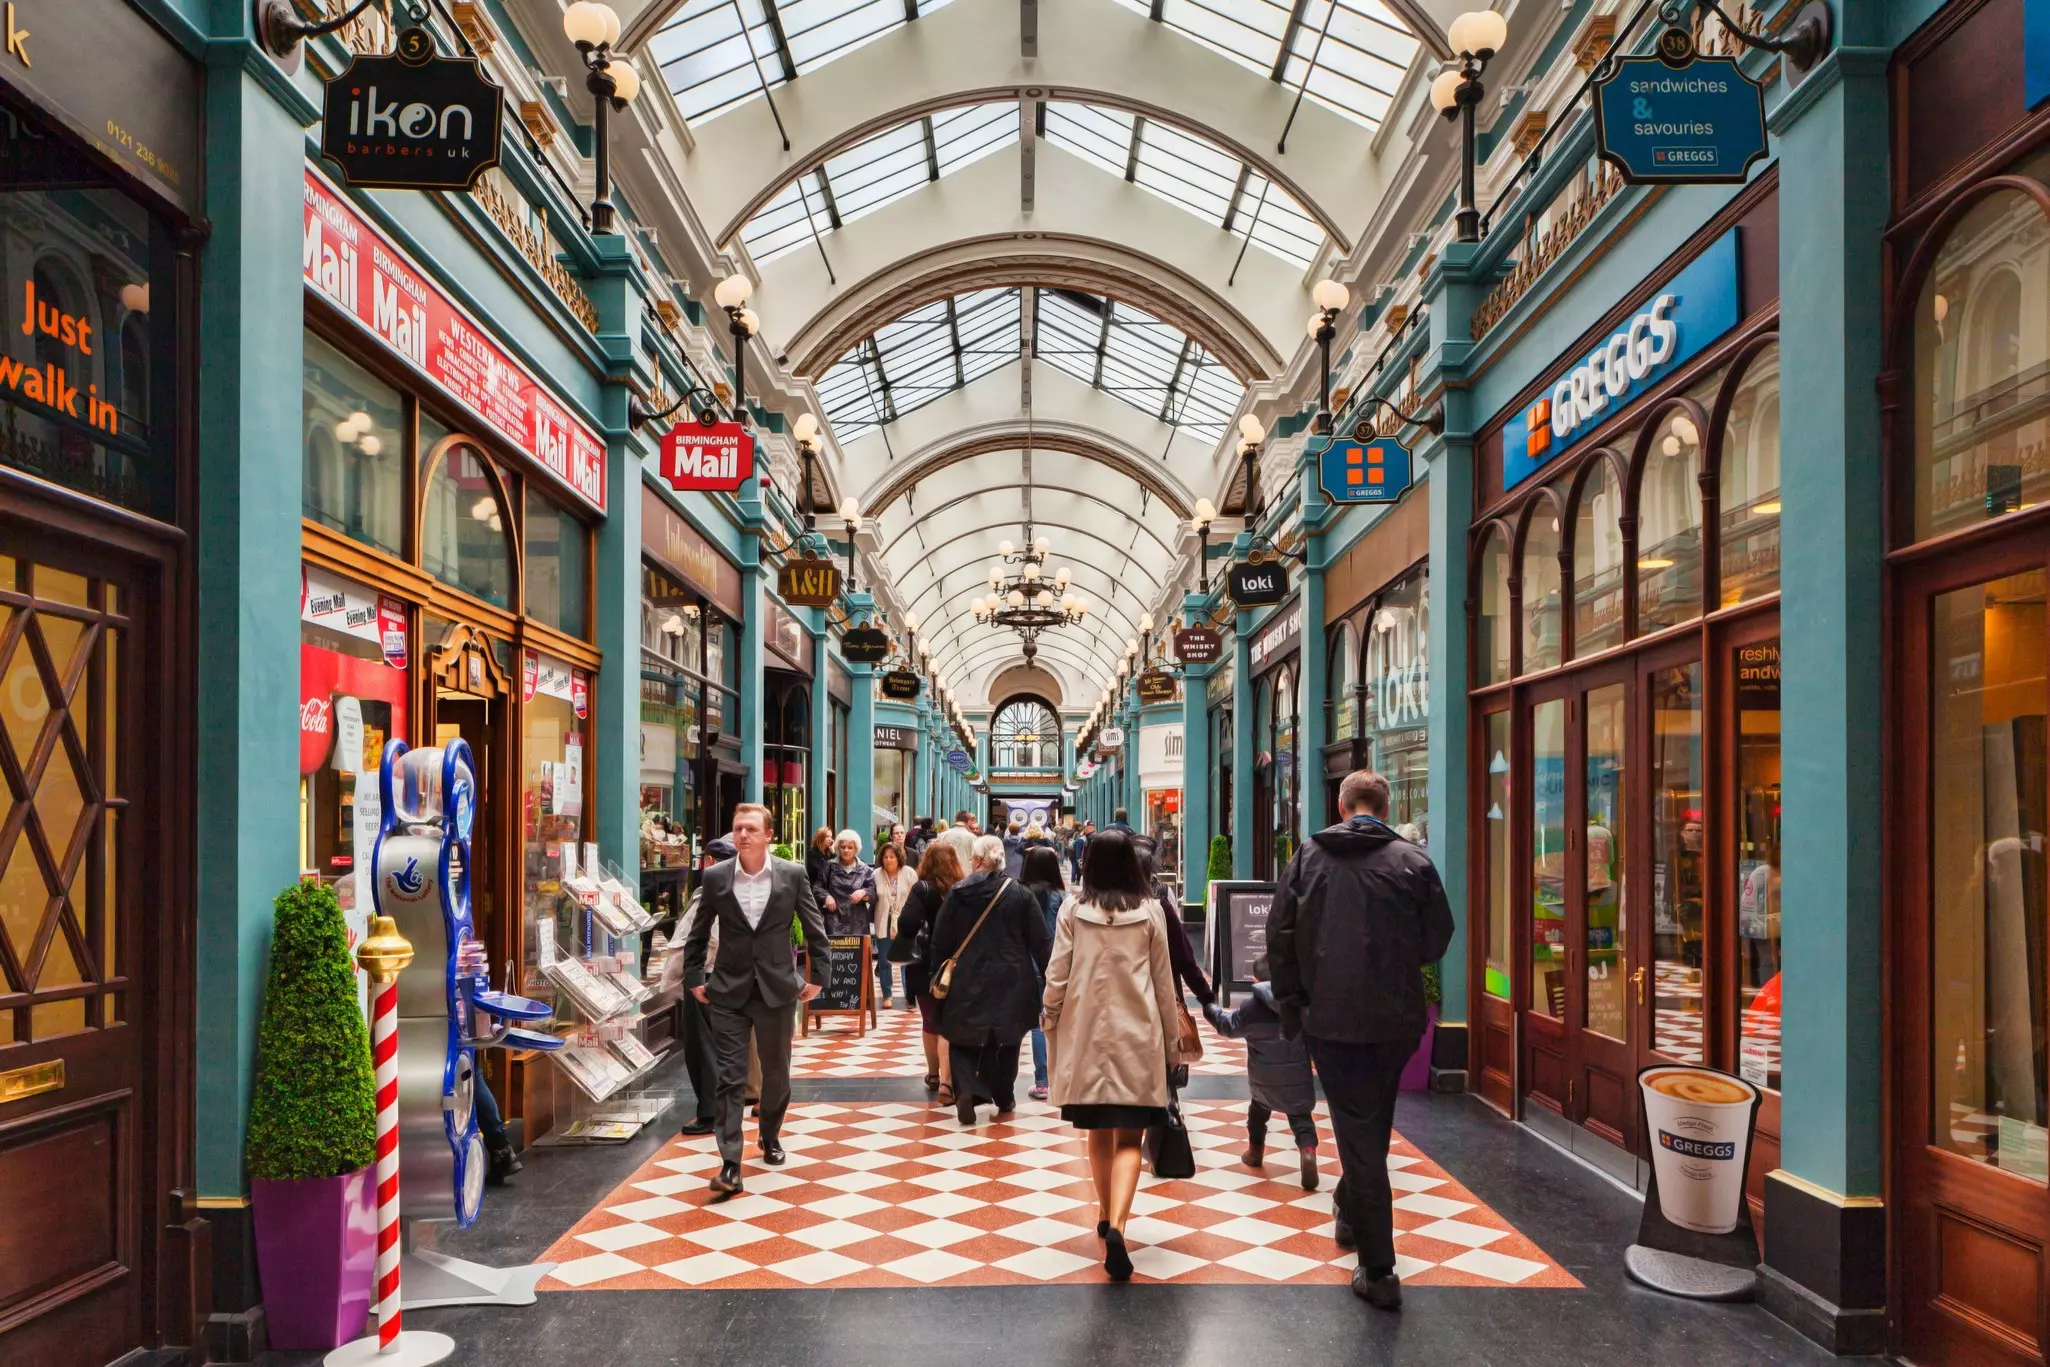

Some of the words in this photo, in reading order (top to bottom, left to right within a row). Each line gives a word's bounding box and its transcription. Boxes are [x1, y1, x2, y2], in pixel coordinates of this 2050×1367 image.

[409, 36, 420, 52] 5
[1666, 35, 1686, 51] 38
[1630, 78, 1728, 93] sandwiches
[350, 86, 473, 140] ikon
[1632, 97, 1652, 119] &
[1634, 120, 1714, 135] savouries
[107, 119, 132, 149] 0121
[136, 142, 155, 167] 236
[347, 142, 433, 157] barbers
[448, 147, 469, 158] uk
[1668, 151, 1714, 161] GREGGS
[303, 181, 358, 246] RMINGHAM
[303, 212, 358, 317] Mail
[373, 245, 427, 307] BIRMINGHAM
[22, 280, 92, 355] Just
[373, 267, 427, 370] Mail
[438, 329, 455, 350] NEWS
[451, 317, 495, 367] WESTERN
[497, 359, 520, 393] NEWS
[1551, 294, 1680, 438] GREGGS
[0, 355, 78, 418] walk
[89, 384, 117, 436] in
[536, 392, 567, 430] BIRMINGHAM
[704, 412, 711, 421] 6
[675, 435, 739, 445] BIRMINGHAM
[1360, 426, 1370, 434] 37
[536, 409, 567, 479] Mail
[674, 446, 738, 478] Mail
[574, 443, 600, 505] Mail
[1355, 488, 1382, 496] GREGGS
[785, 568, 834, 597] A&H
[1242, 575, 1274, 591] loki
[310, 597, 333, 614] Evening
[333, 592, 345, 608] Mail
[346, 610, 367, 625] Evening
[1740, 646, 1780, 664] reshly
[1740, 665, 1780, 679] andw
[873, 728, 902, 741] NIEL
[1164, 730, 1183, 757] sim
[359, 807, 380, 817] SELLING
[579, 892, 599, 906] Mail
[1674, 1138, 1732, 1158] GREGGS
